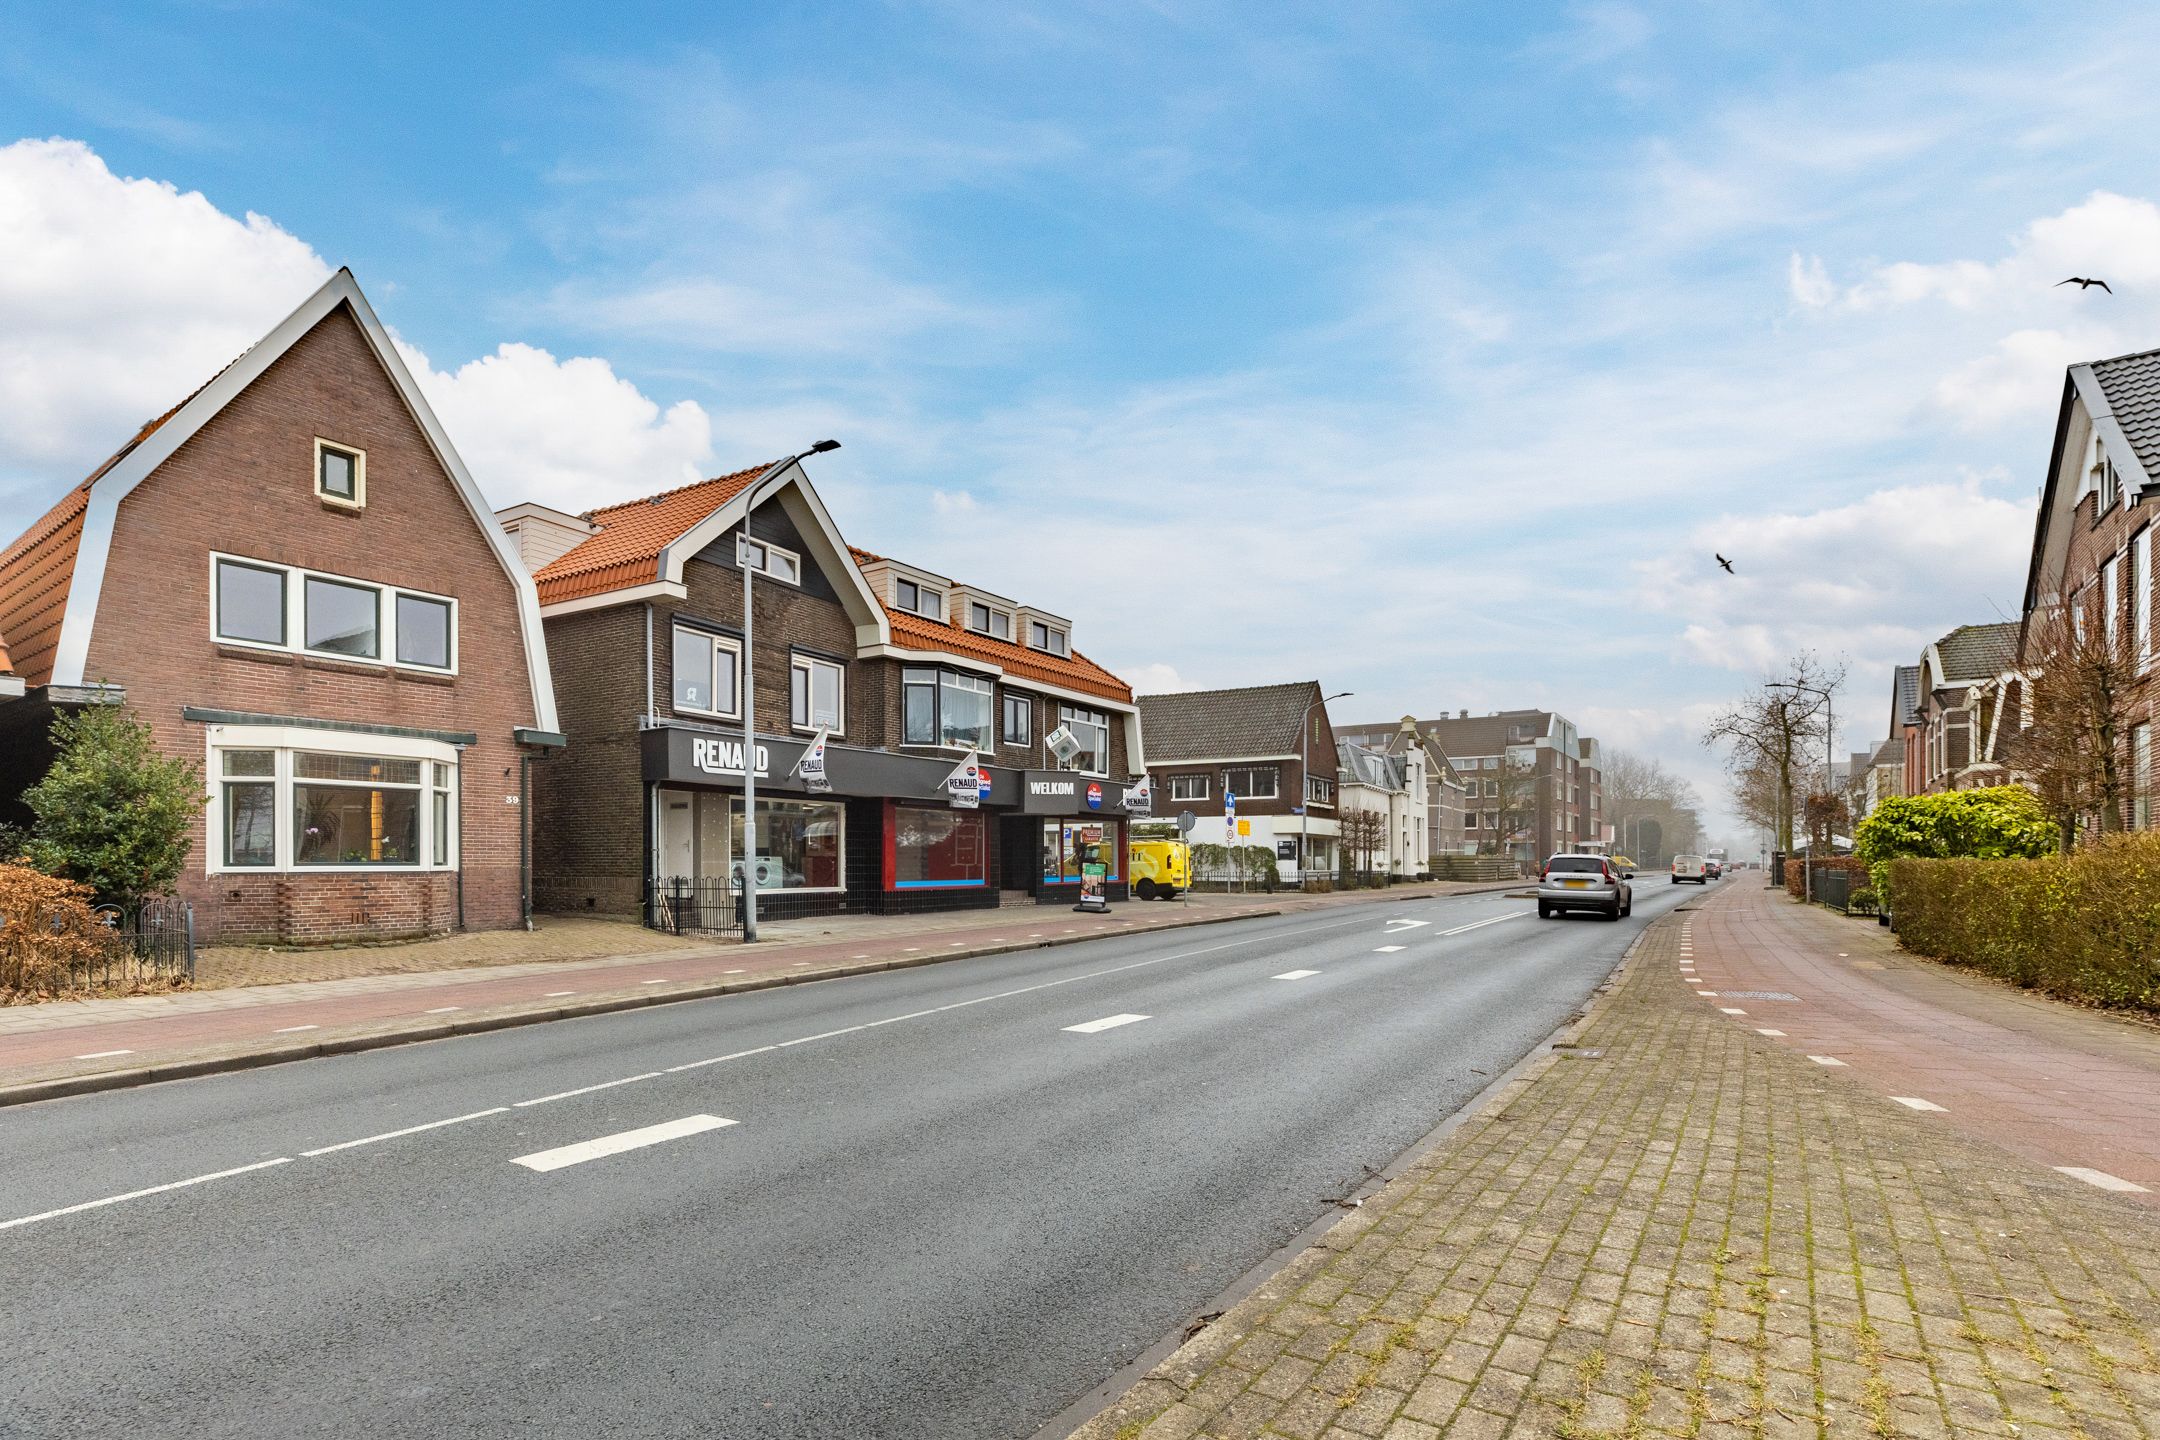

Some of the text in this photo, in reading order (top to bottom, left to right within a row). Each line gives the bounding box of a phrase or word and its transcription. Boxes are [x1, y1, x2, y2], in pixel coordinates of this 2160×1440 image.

[693, 738, 769, 778] RENAD
[949, 778, 977, 789] RENAUD
[1030, 782, 1074, 795] WELKOM
[506, 796, 519, 804] 39
[1126, 798, 1149, 806] RENAUD
